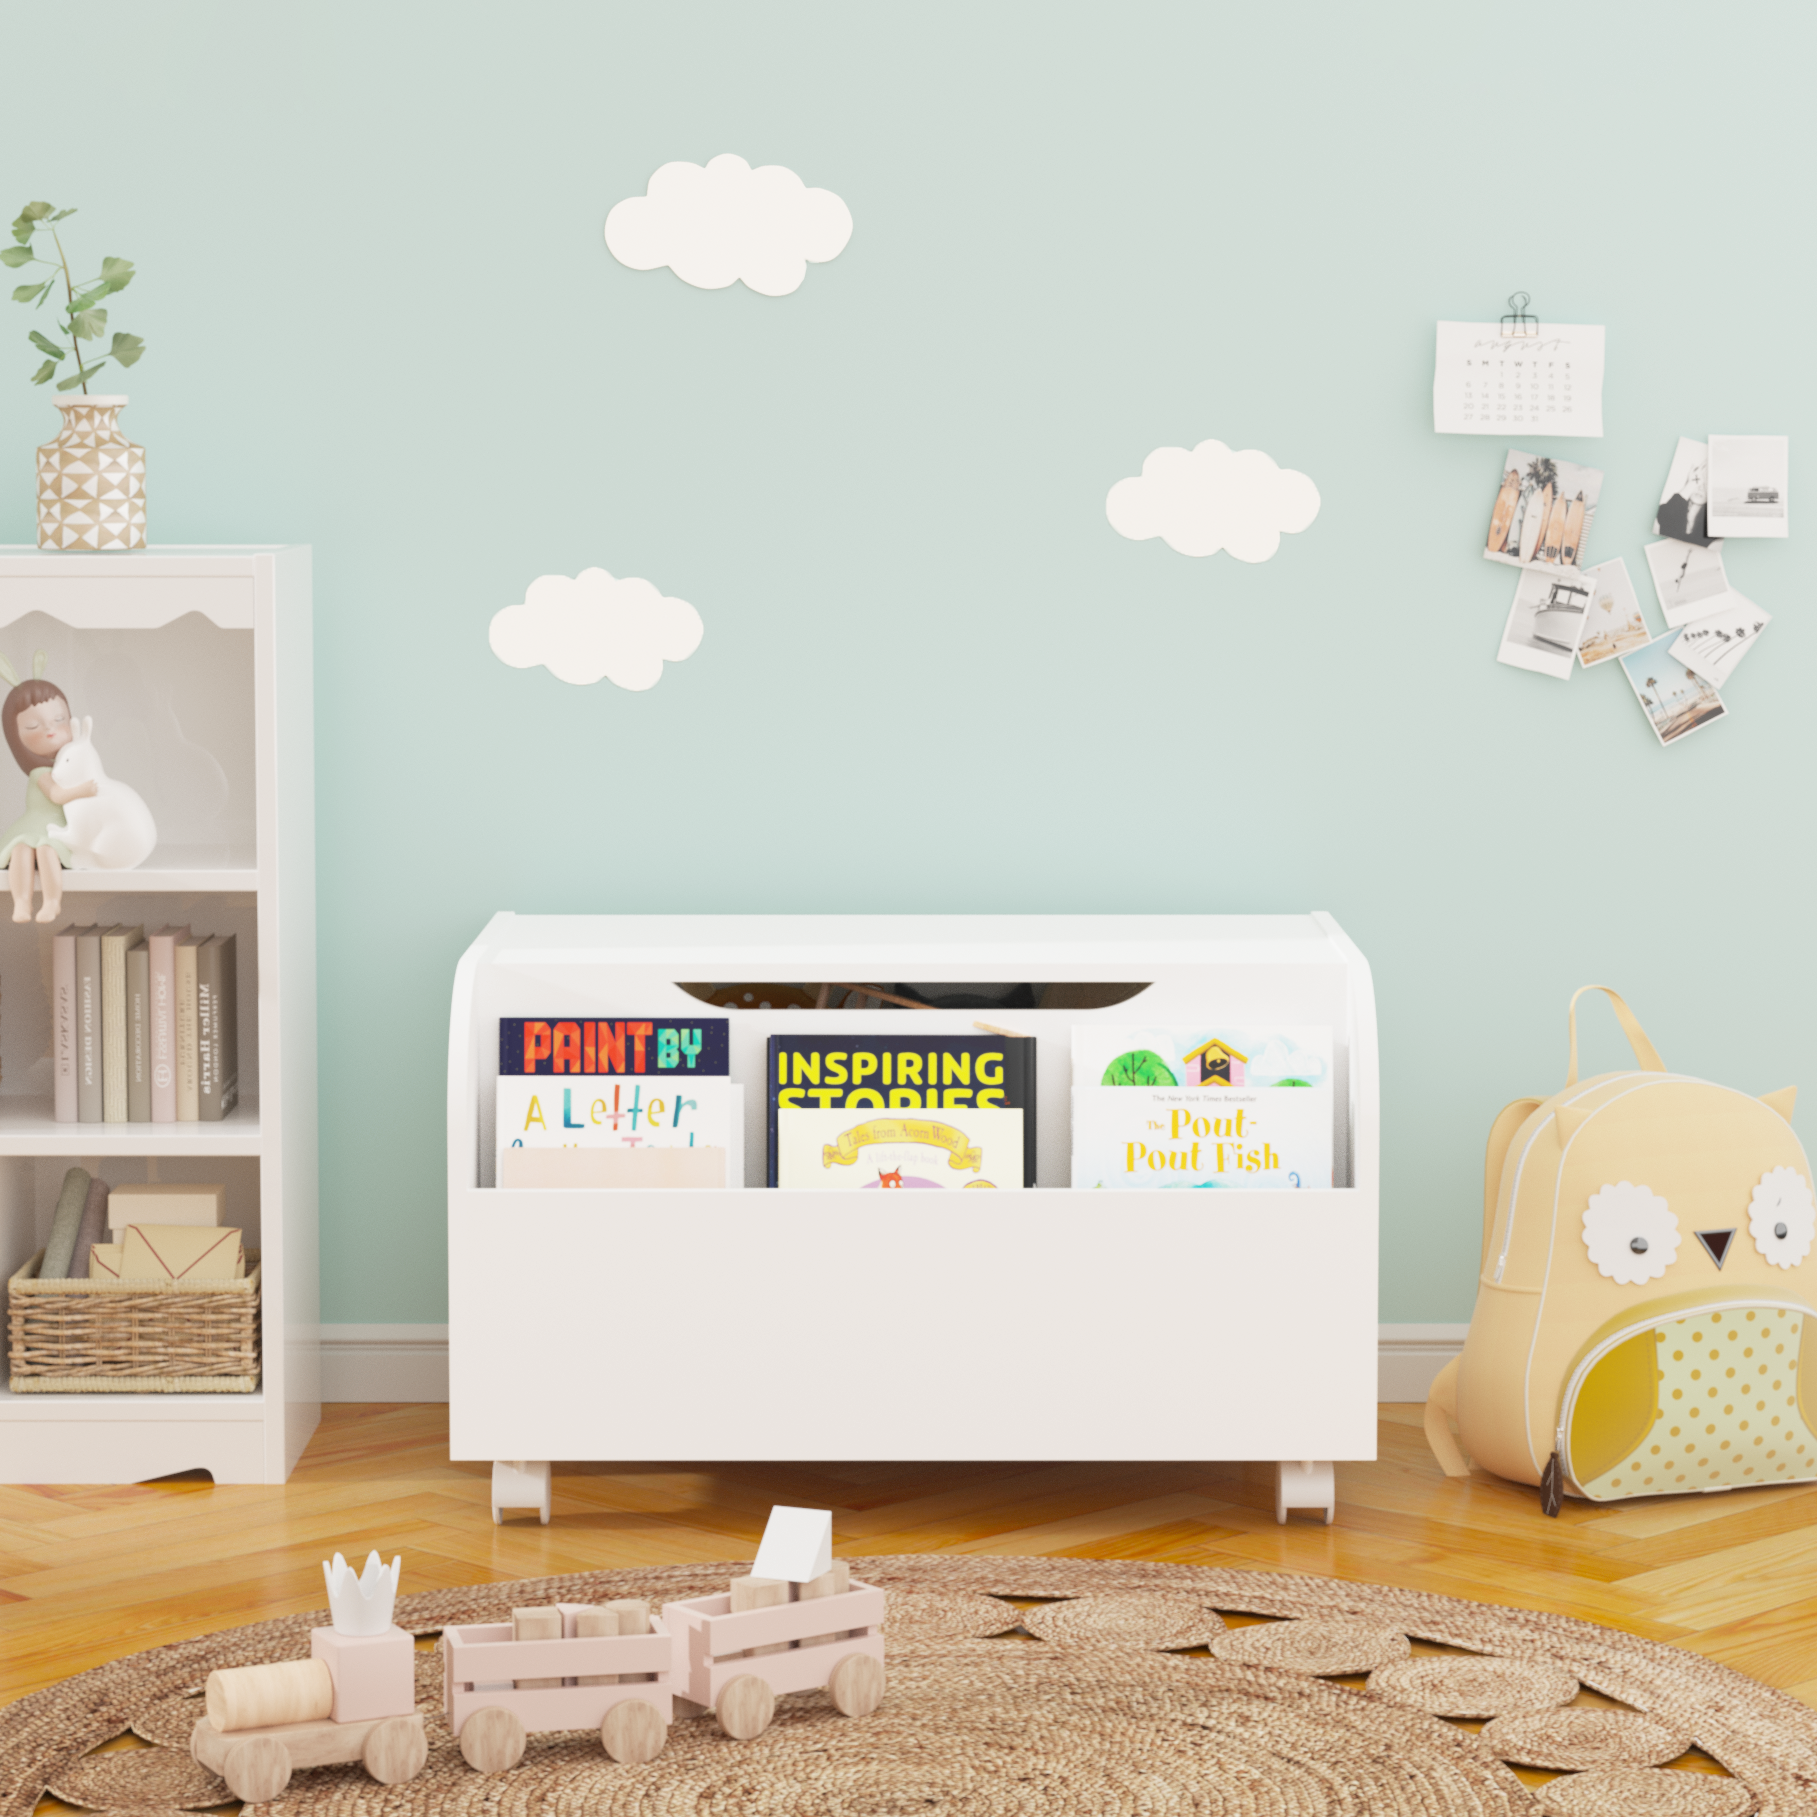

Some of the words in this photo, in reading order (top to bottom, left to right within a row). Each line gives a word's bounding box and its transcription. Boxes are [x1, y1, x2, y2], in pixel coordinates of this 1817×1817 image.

[524, 1021, 653, 1073] PAINT
[657, 1028, 702, 1068] BY
[778, 1052, 1004, 1086] INSPIRING
[524, 1095, 546, 1131] A
[563, 1084, 697, 1131] Letter
[1147, 1120, 1165, 1130] The
[1166, 1108, 1257, 1140] Pout-
[844, 1130, 870, 1147] Tales
[873, 1125, 896, 1139] from
[901, 1123, 929, 1139] Acorn
[932, 1125, 960, 1149] Wood
[921, 1153, 938, 1165] book
[1121, 1141, 1204, 1173] Pout
[1211, 1142, 1281, 1174] Fish
